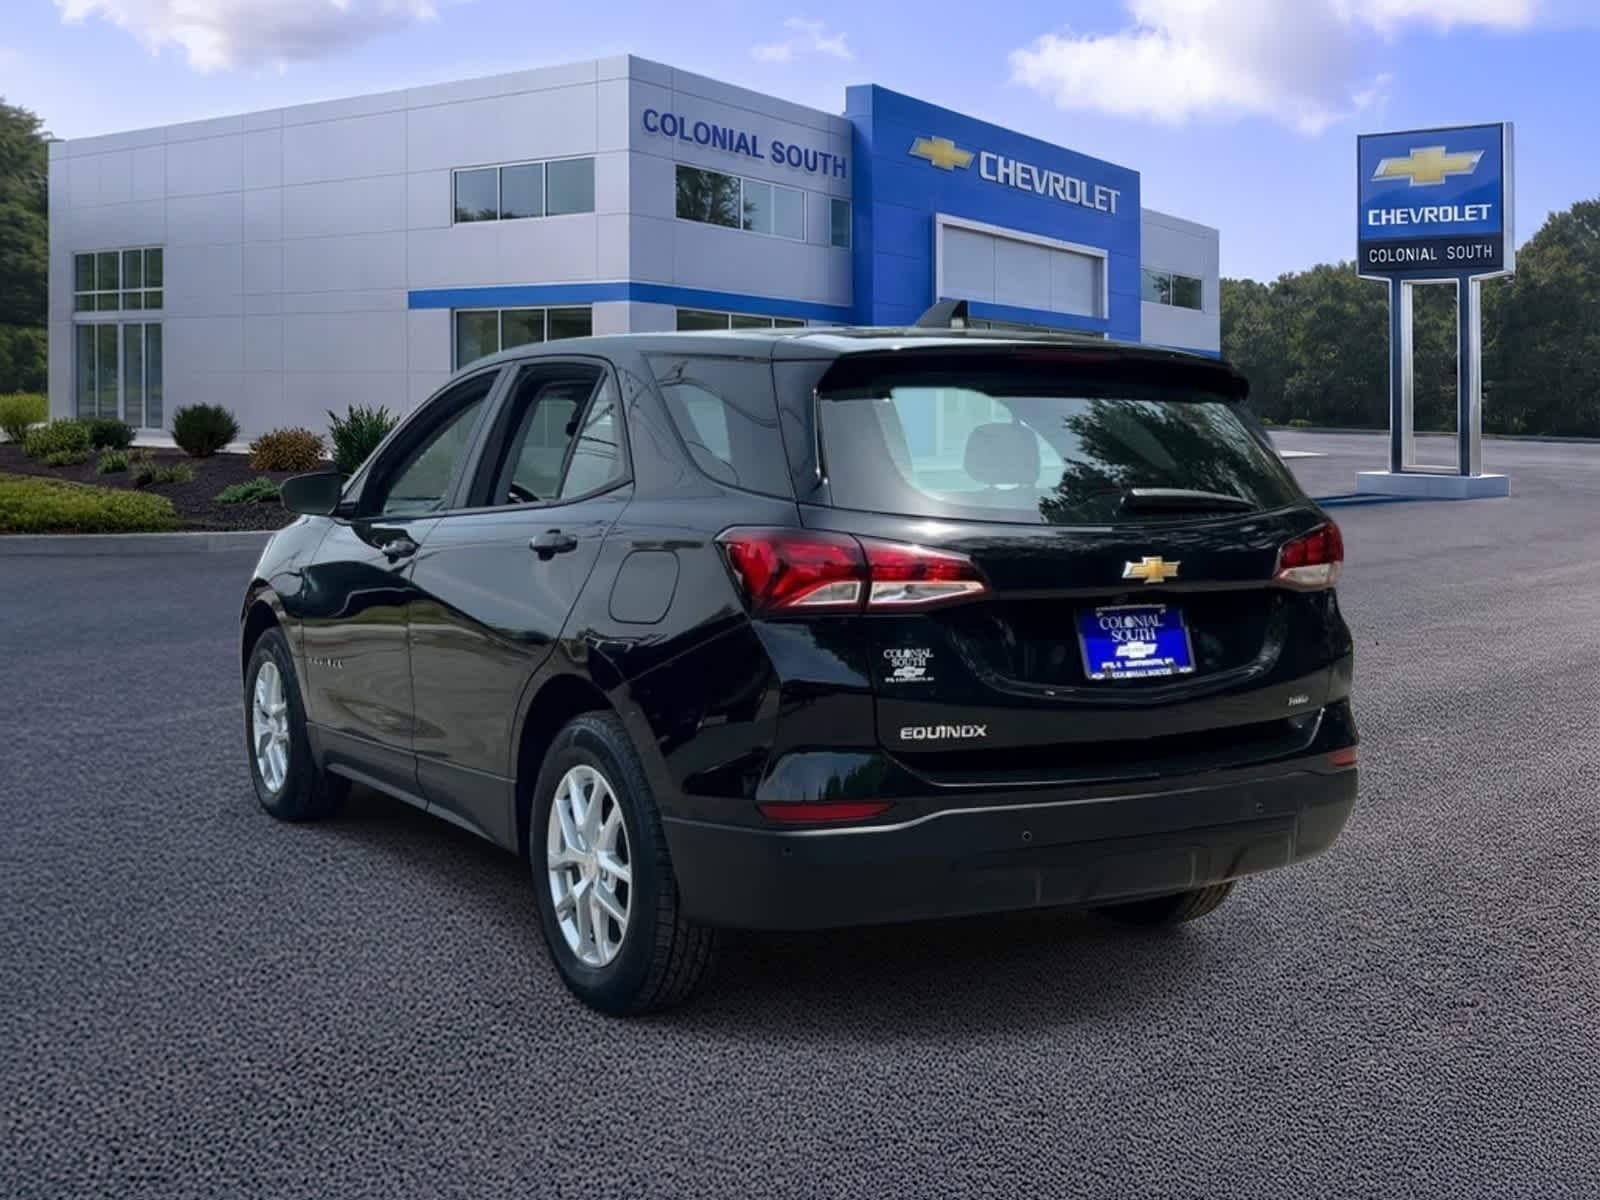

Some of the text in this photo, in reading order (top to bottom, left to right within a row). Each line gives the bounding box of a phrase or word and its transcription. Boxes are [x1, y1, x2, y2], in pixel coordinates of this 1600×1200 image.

[642, 108, 847, 179] COLONIAL SOUTH
[978, 151, 1121, 215] CHEVROLET
[1368, 204, 1492, 226] CHEVROLET
[1369, 245, 1493, 263] COLONIAL SOUTH
[1099, 614, 1164, 630] COLONIAL
[1111, 627, 1157, 642] SOUTH
[883, 648, 934, 659] COLONIAL
[891, 657, 927, 667] SOUTH
[900, 725, 987, 739] EQUINOX
